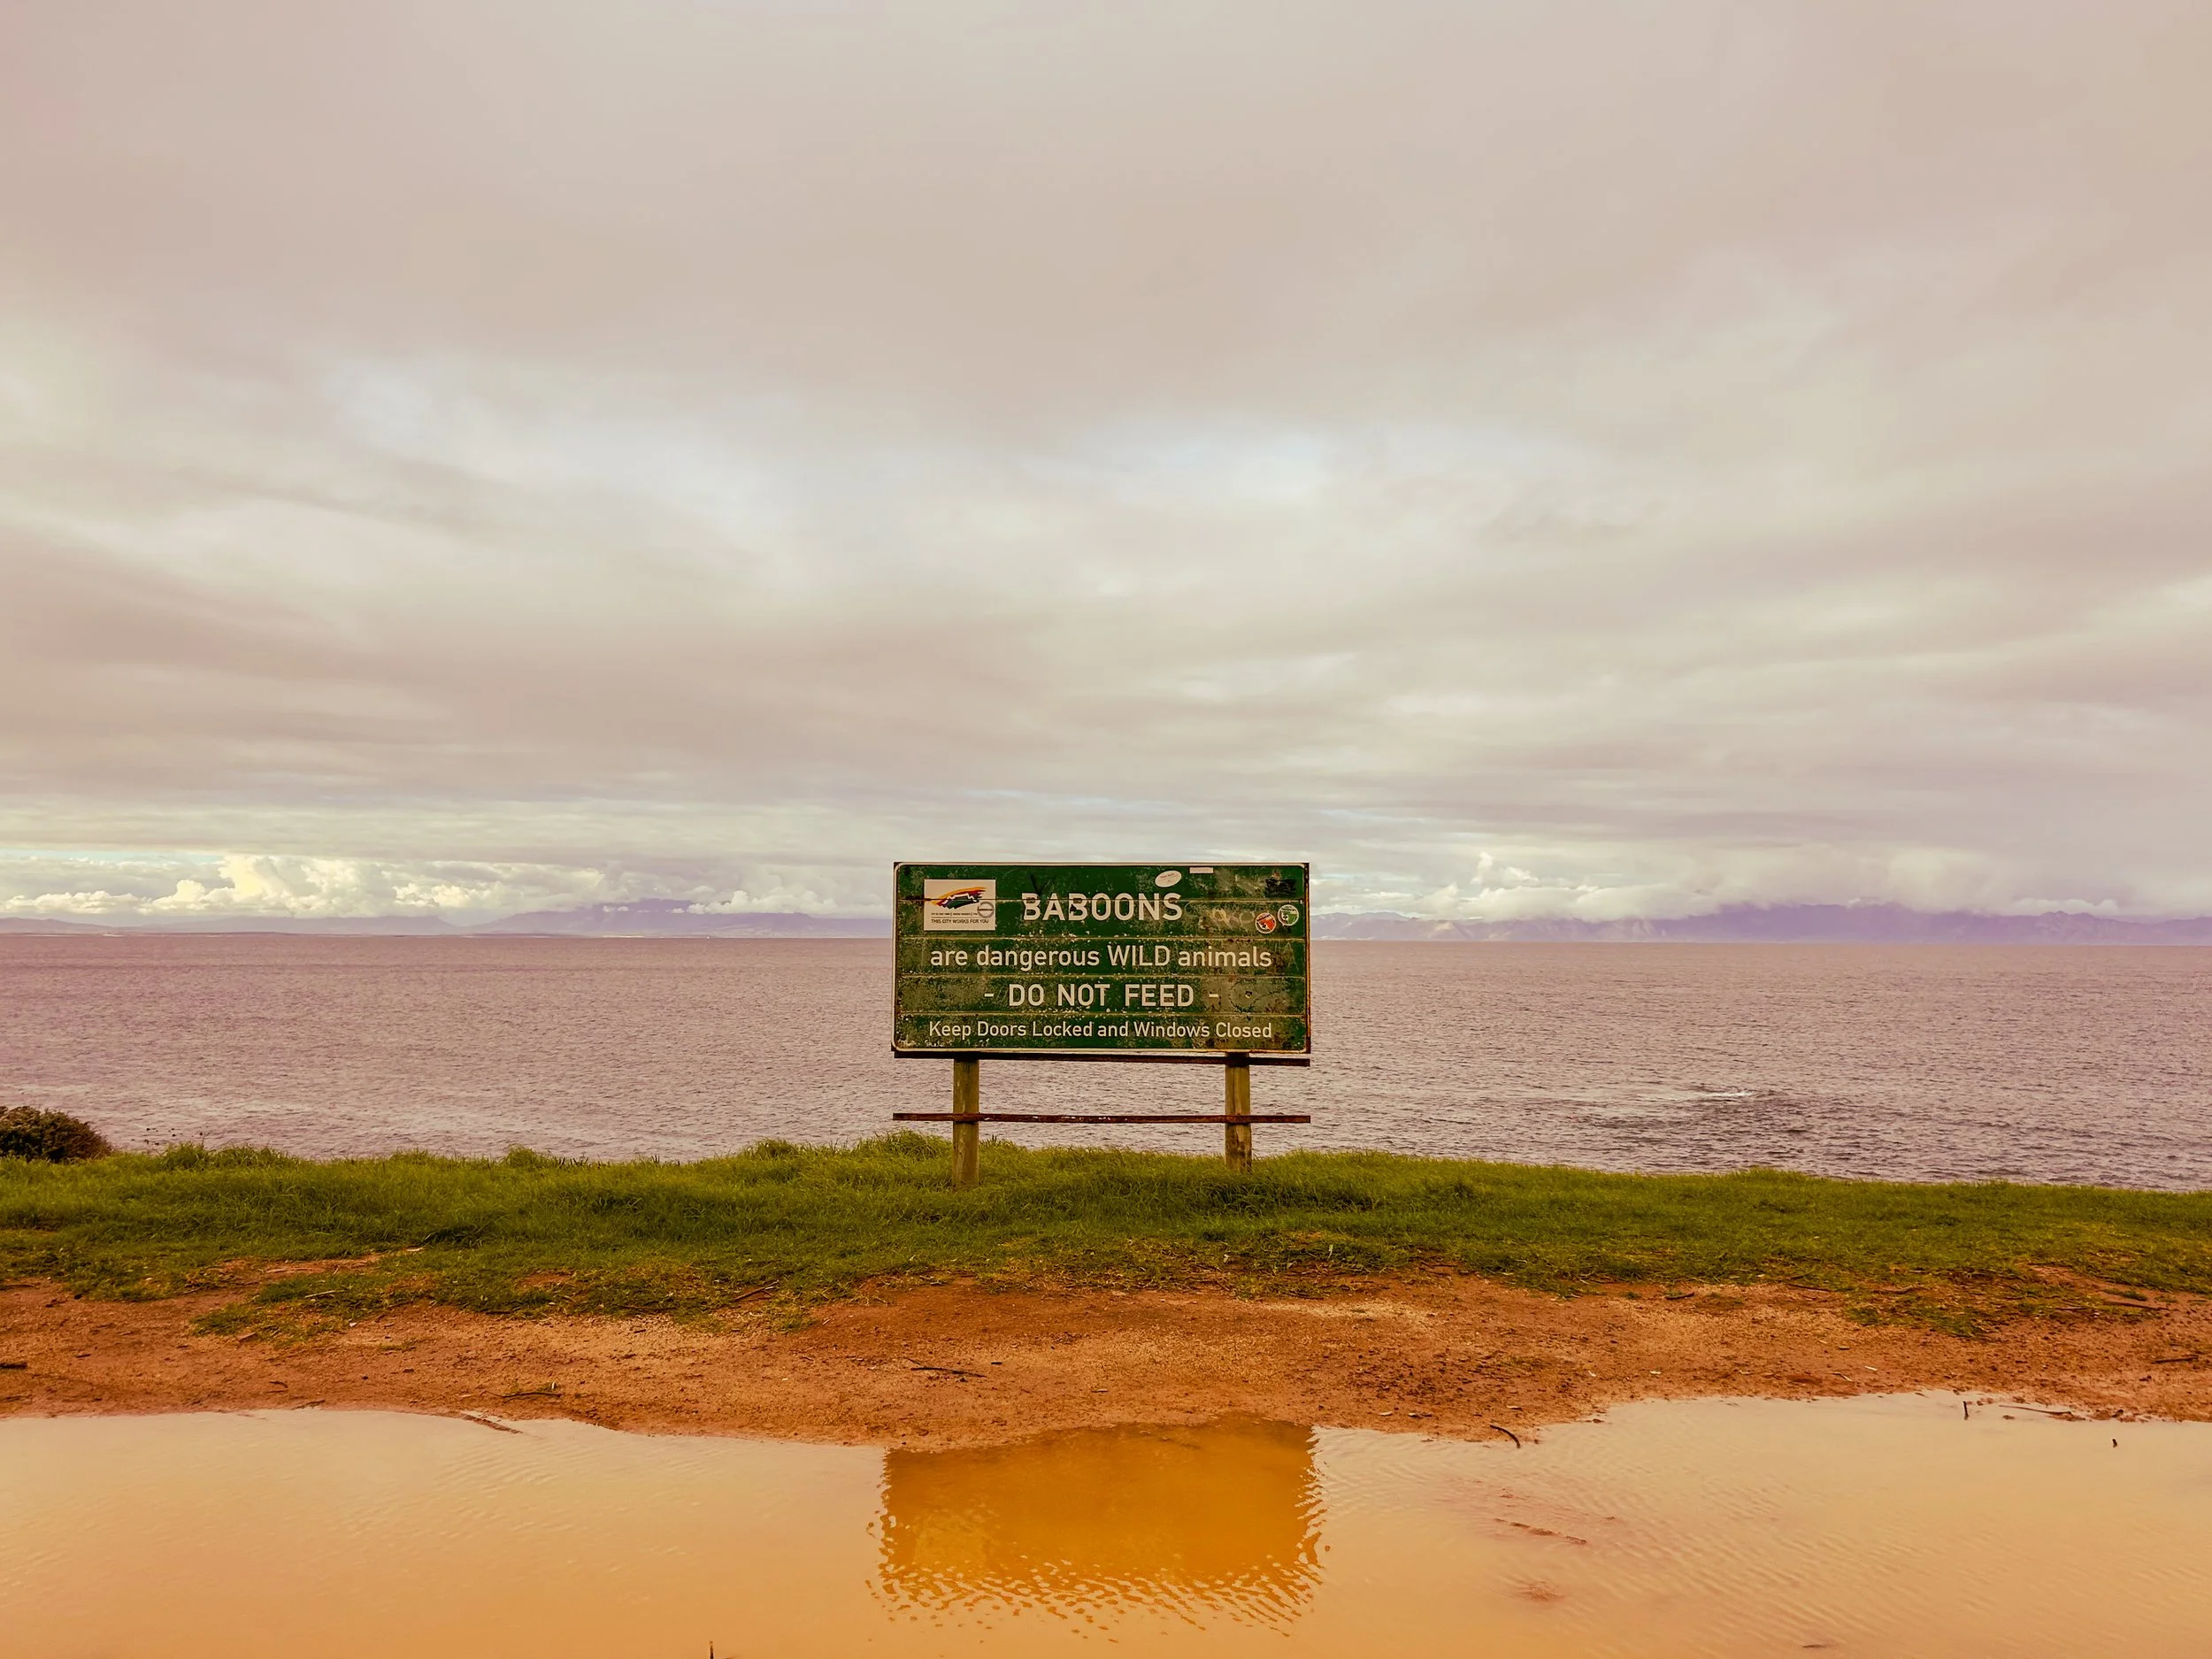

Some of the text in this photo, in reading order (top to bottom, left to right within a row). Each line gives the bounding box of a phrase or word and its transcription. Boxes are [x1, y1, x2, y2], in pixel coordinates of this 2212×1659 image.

[1021, 893, 1183, 921] BABOONS
[930, 950, 967, 966] are
[976, 946, 1100, 971] dangerous
[1108, 945, 1171, 966] WILD
[1178, 946, 1271, 966] animals
[1009, 984, 1043, 1006] DO
[1057, 984, 1110, 1007] NOT
[1125, 984, 1194, 1007] FEED
[929, 1021, 1272, 1040] Keep Doors Locked and Windows Closed
